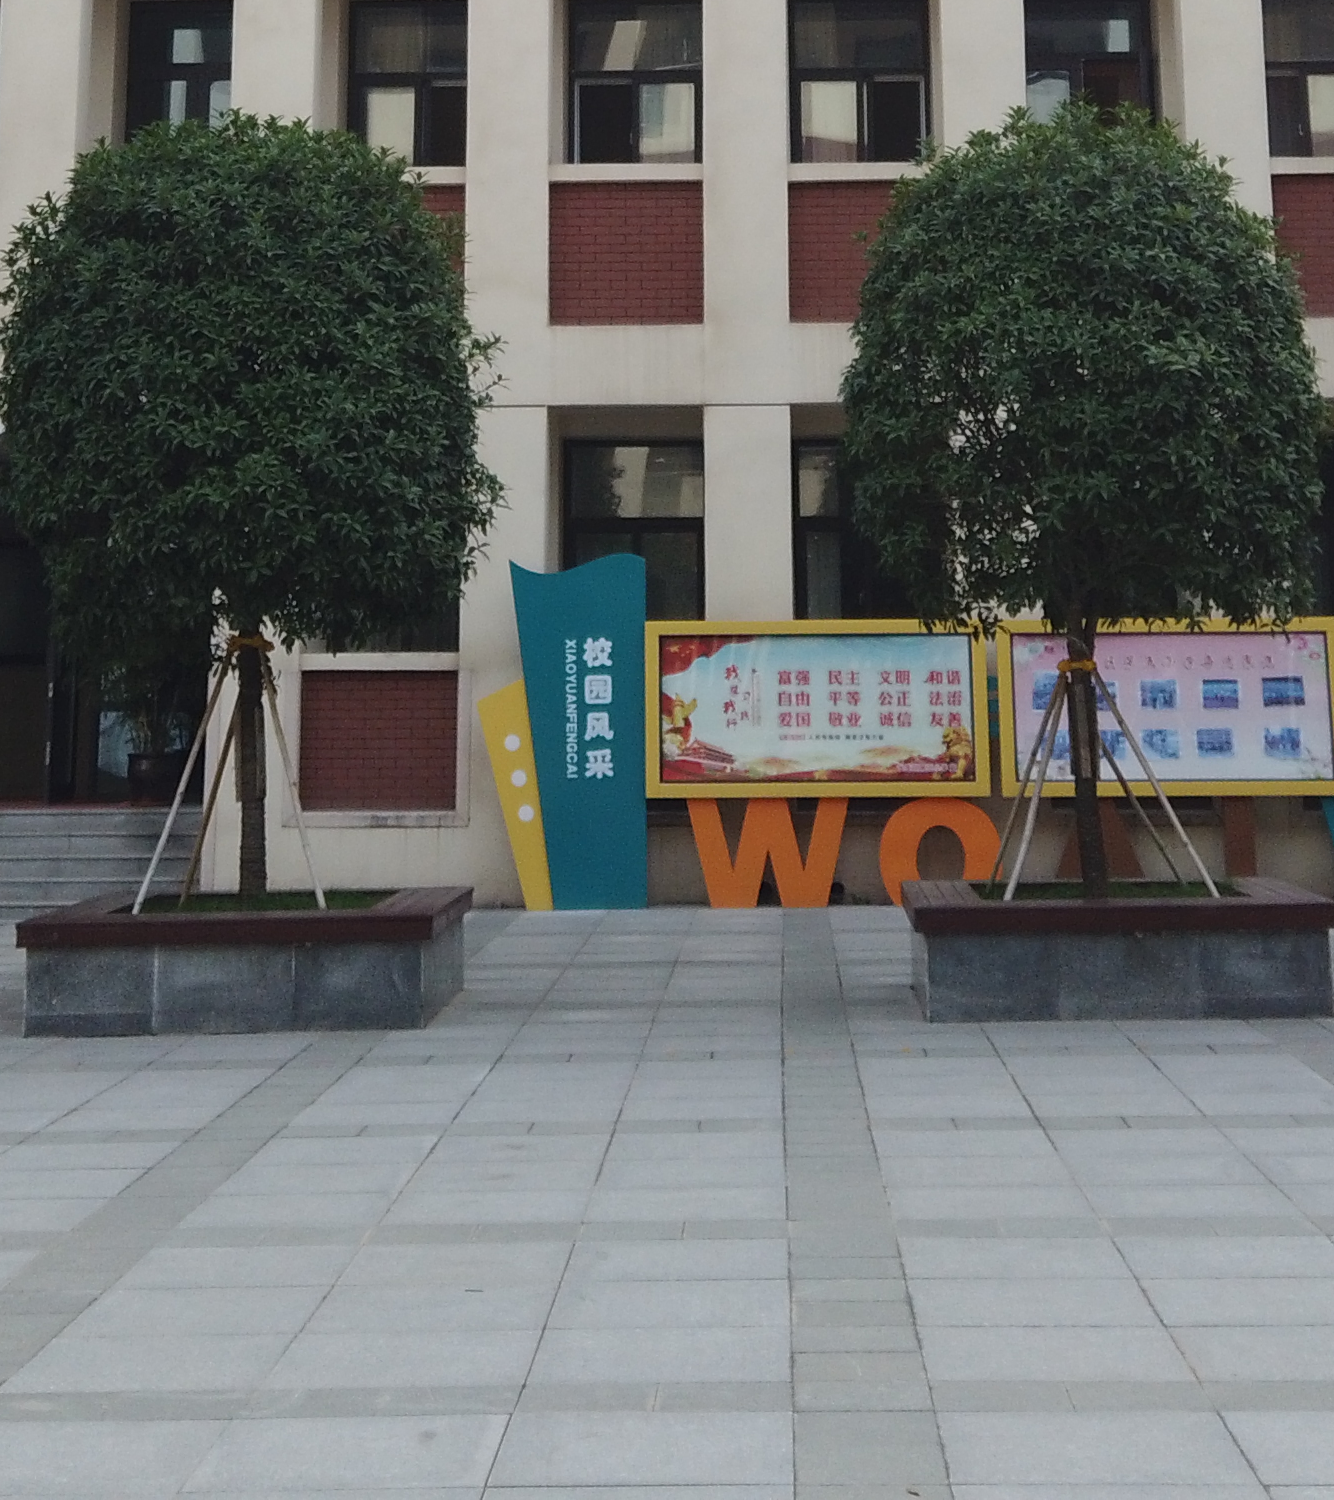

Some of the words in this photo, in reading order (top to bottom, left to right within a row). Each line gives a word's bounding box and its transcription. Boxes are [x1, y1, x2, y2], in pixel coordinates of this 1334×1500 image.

[778, 670, 810, 685] 富强
[828, 670, 860, 685] 民主
[879, 670, 910, 685] 文明
[925, 670, 961, 685] 和谐
[778, 691, 810, 706] 自由
[829, 691, 861, 706] 平等
[879, 691, 910, 706] 公正
[930, 690, 962, 706] 法治
[565, 639, 578, 778] XIAOYUANFENGCAI
[583, 637, 614, 779] 校园风采
[779, 712, 811, 727] 爱国
[828, 712, 861, 727] 敬业
[879, 711, 911, 727] 诚信
[930, 712, 962, 727] 友善
